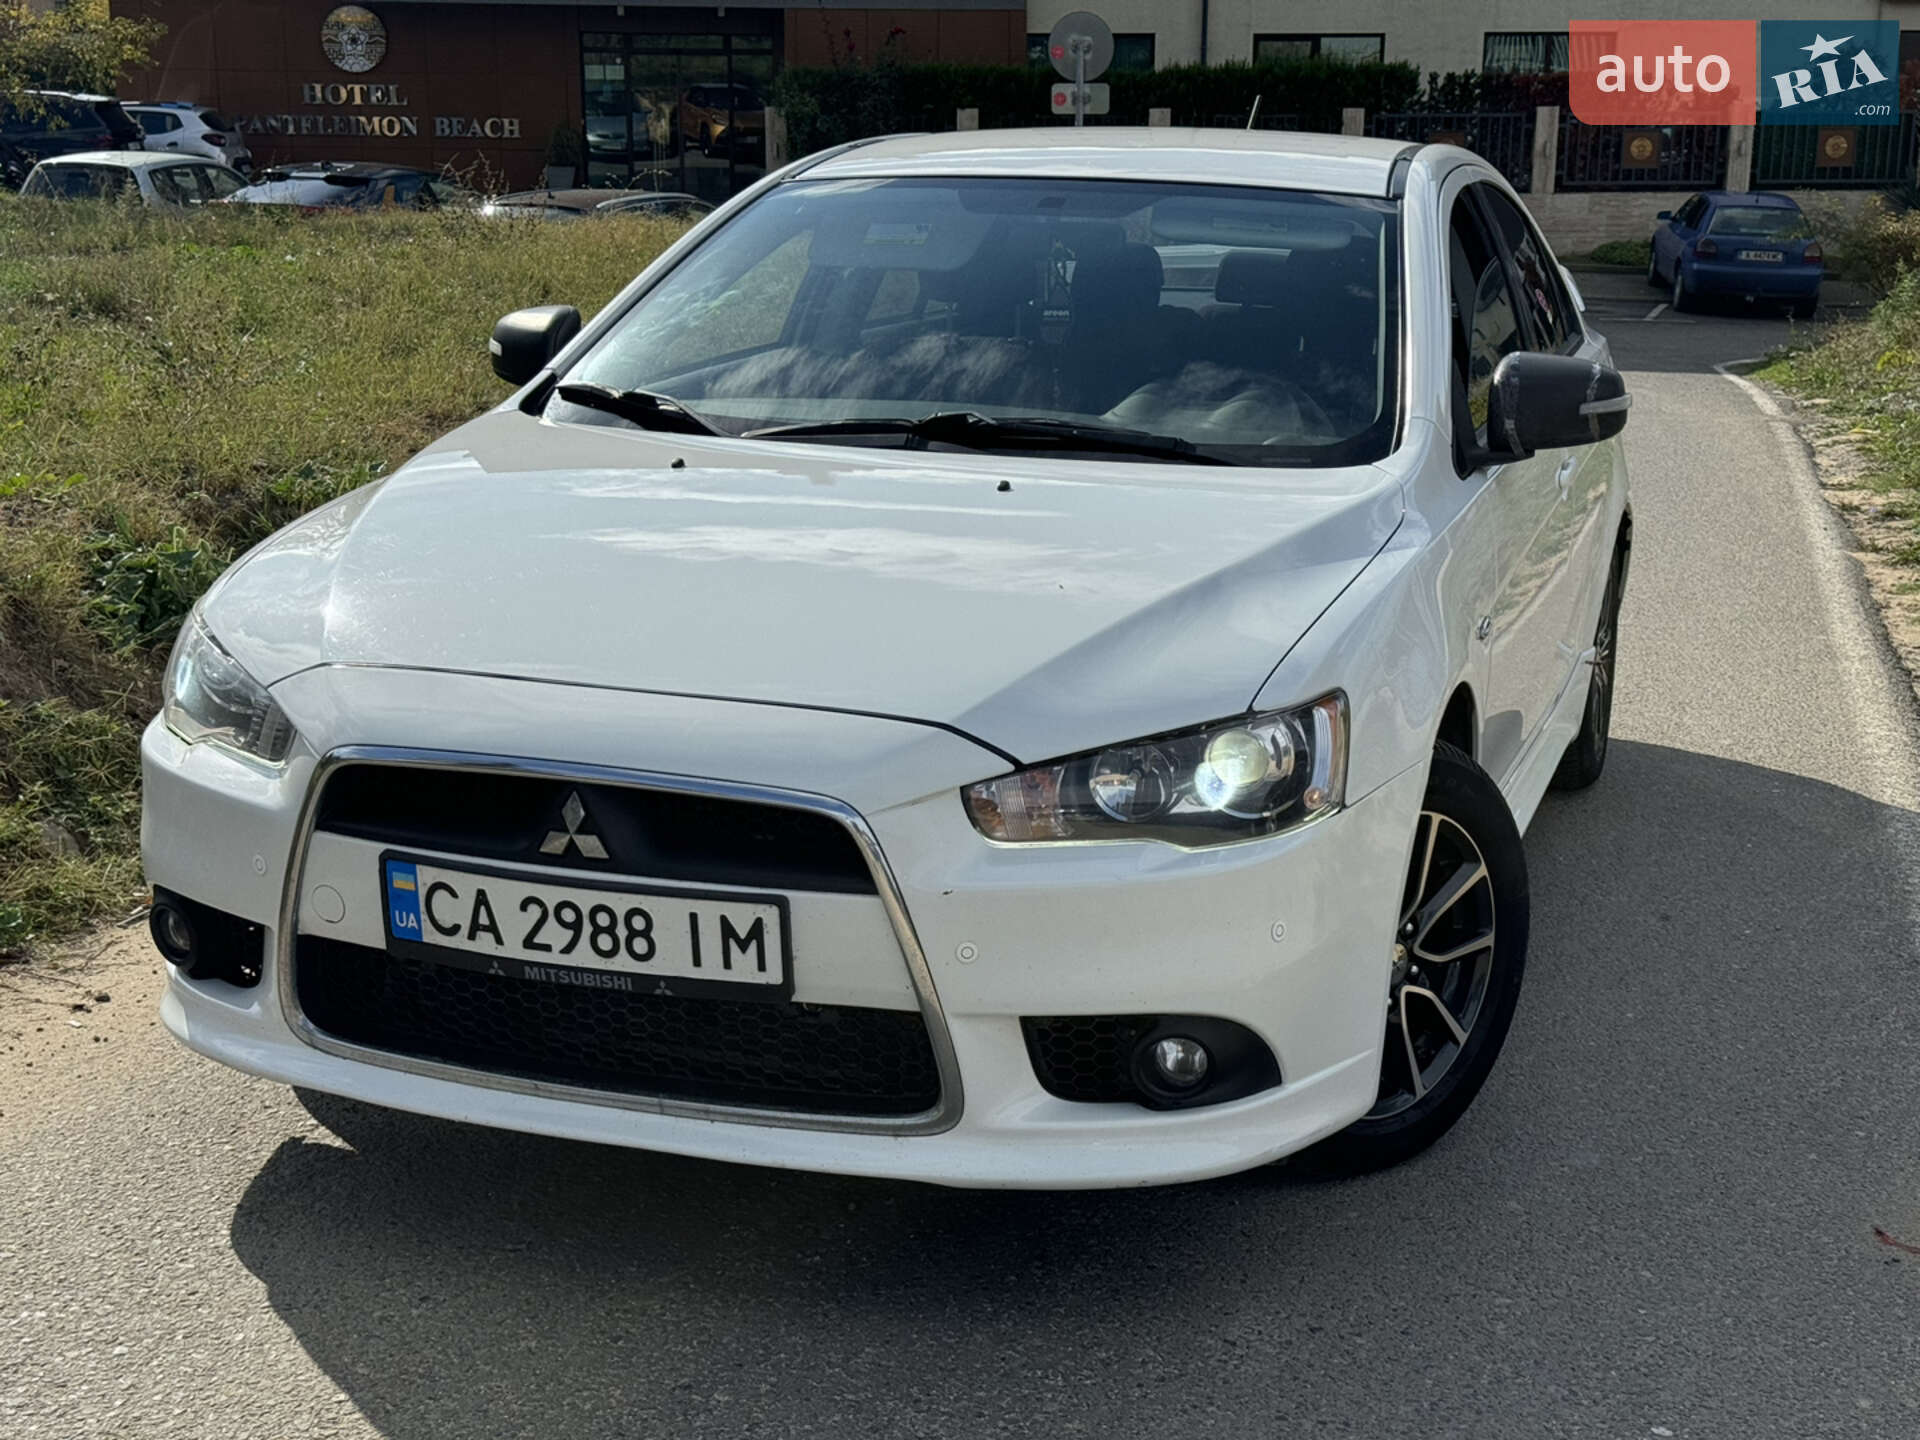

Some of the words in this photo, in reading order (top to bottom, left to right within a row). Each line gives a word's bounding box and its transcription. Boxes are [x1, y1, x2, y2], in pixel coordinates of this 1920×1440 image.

[302, 83, 408, 106] HOTEL
[434, 116, 521, 139] BEACH
[395, 910, 419, 930] UA
[425, 881, 505, 947] CA
[519, 895, 657, 963] 2988
[688, 911, 767, 973] IM
[523, 965, 633, 991] MITSUBISHI
